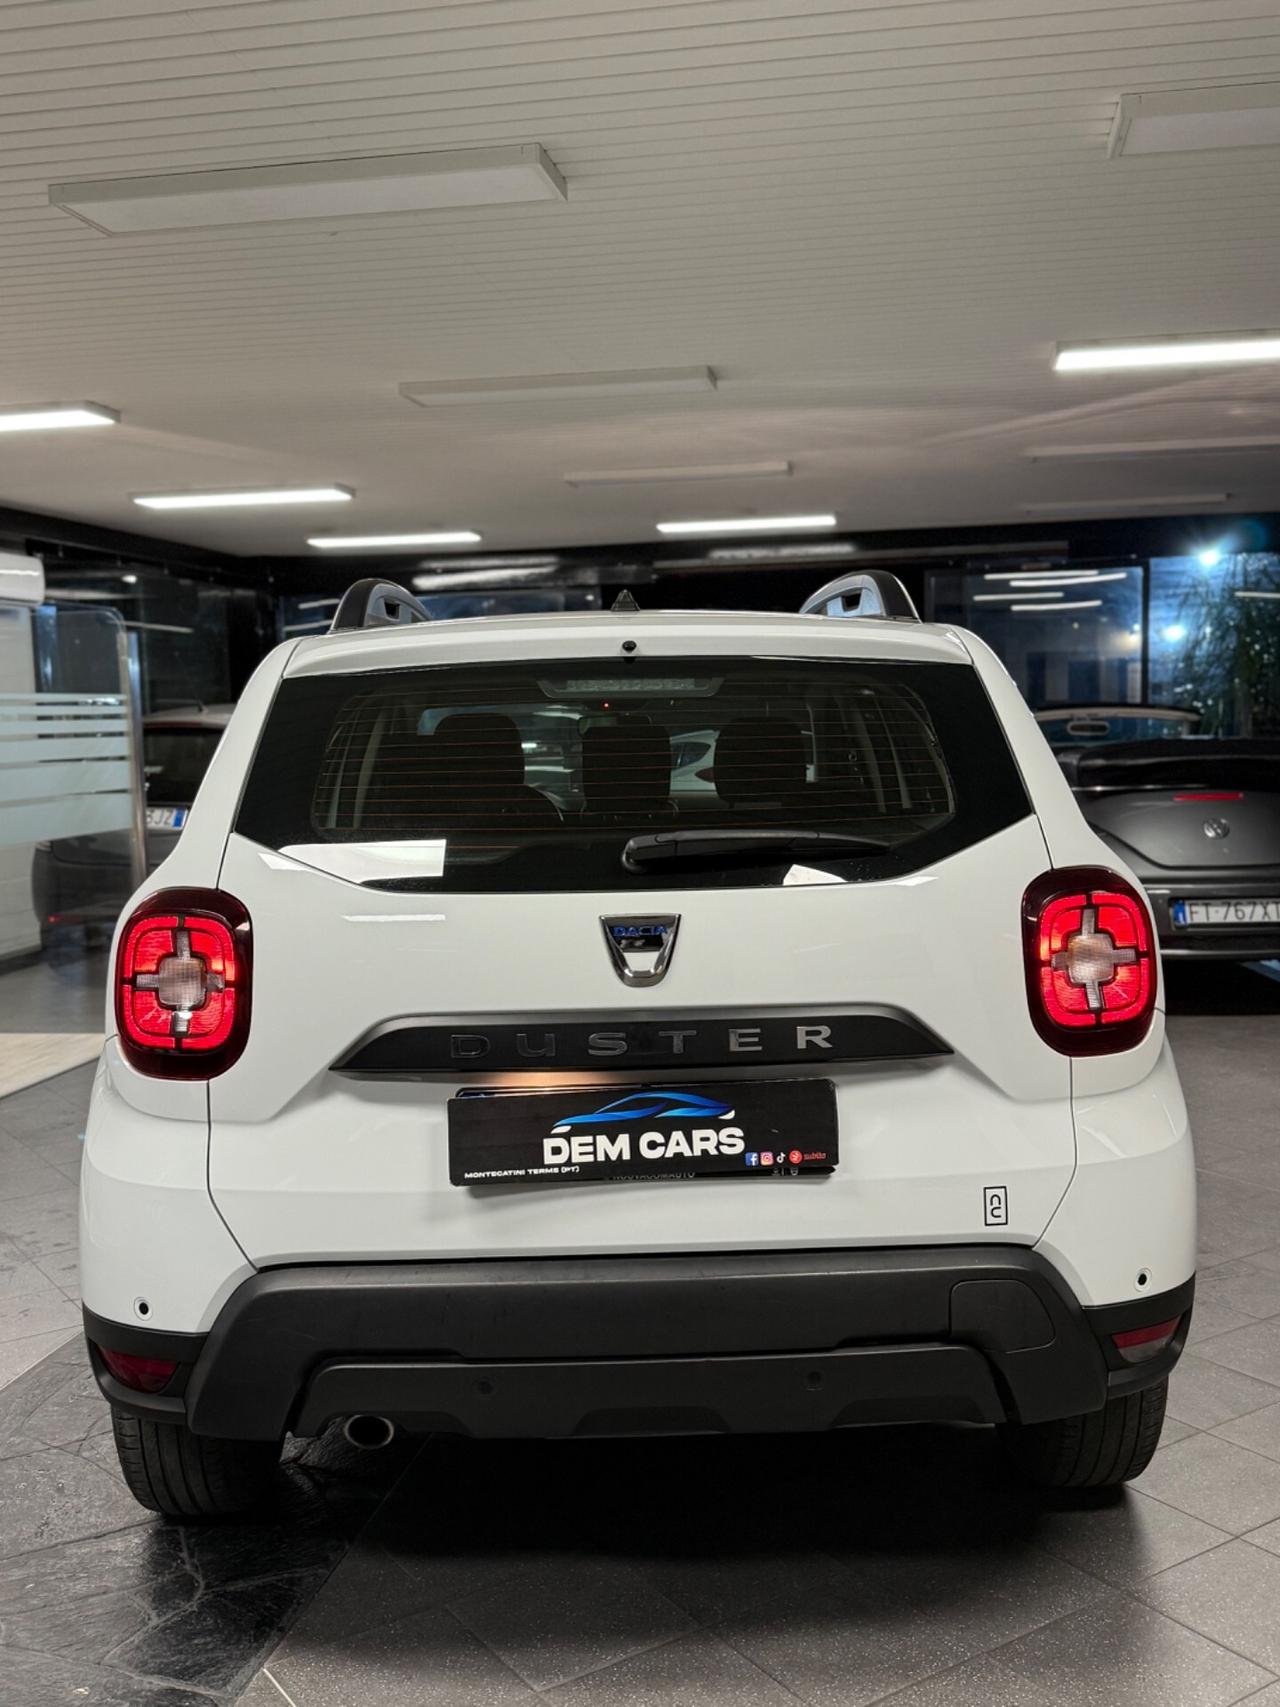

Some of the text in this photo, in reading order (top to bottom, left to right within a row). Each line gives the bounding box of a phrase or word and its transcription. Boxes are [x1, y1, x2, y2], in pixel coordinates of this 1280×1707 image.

[612, 924, 668, 937] DACIA
[450, 1025, 833, 1059] DUSTER
[542, 1127, 745, 1165] DEM CARS
[464, 1169, 526, 1179] MONTECATINI
